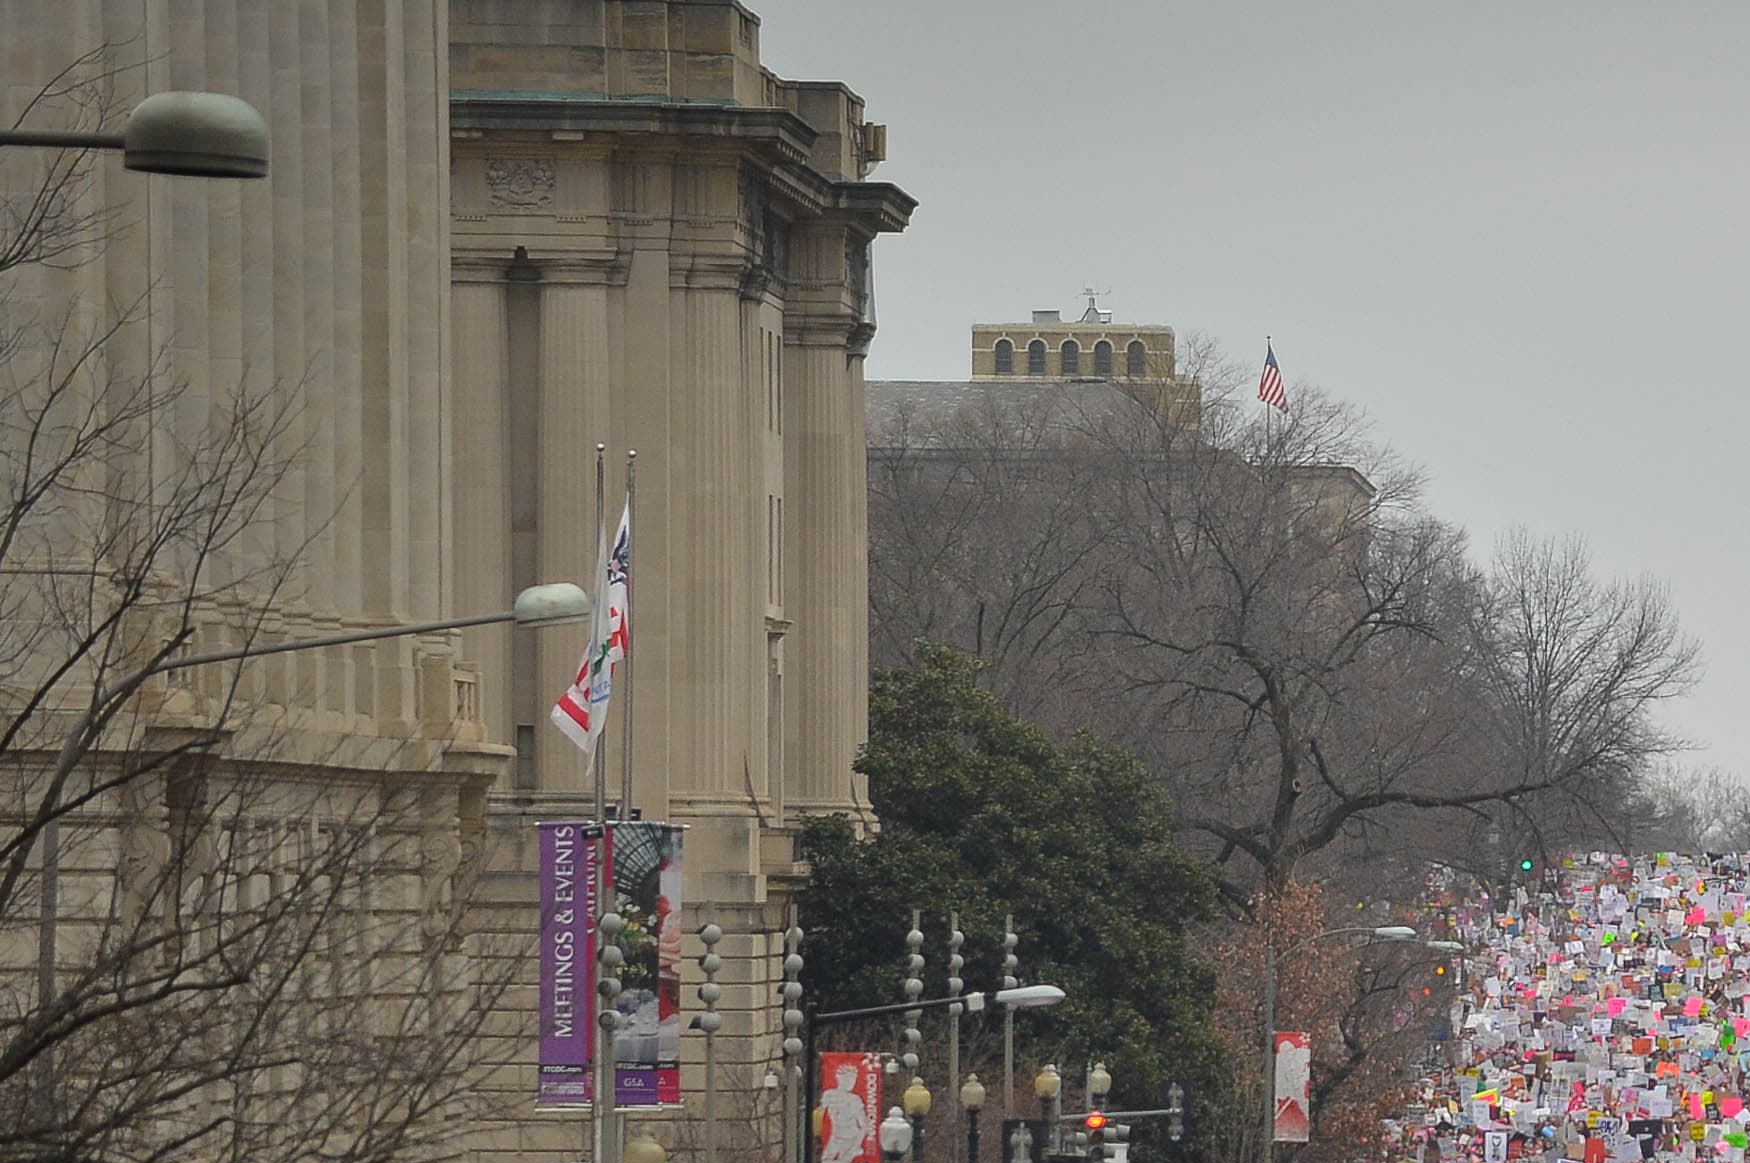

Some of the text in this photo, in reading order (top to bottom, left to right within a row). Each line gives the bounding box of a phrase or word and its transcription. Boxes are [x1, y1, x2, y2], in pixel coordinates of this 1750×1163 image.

[554, 826, 574, 1037] MEETINGS & EVENTS
[623, 1077, 645, 1087] GSA
[866, 1074, 878, 1141] DOWNTOWN
